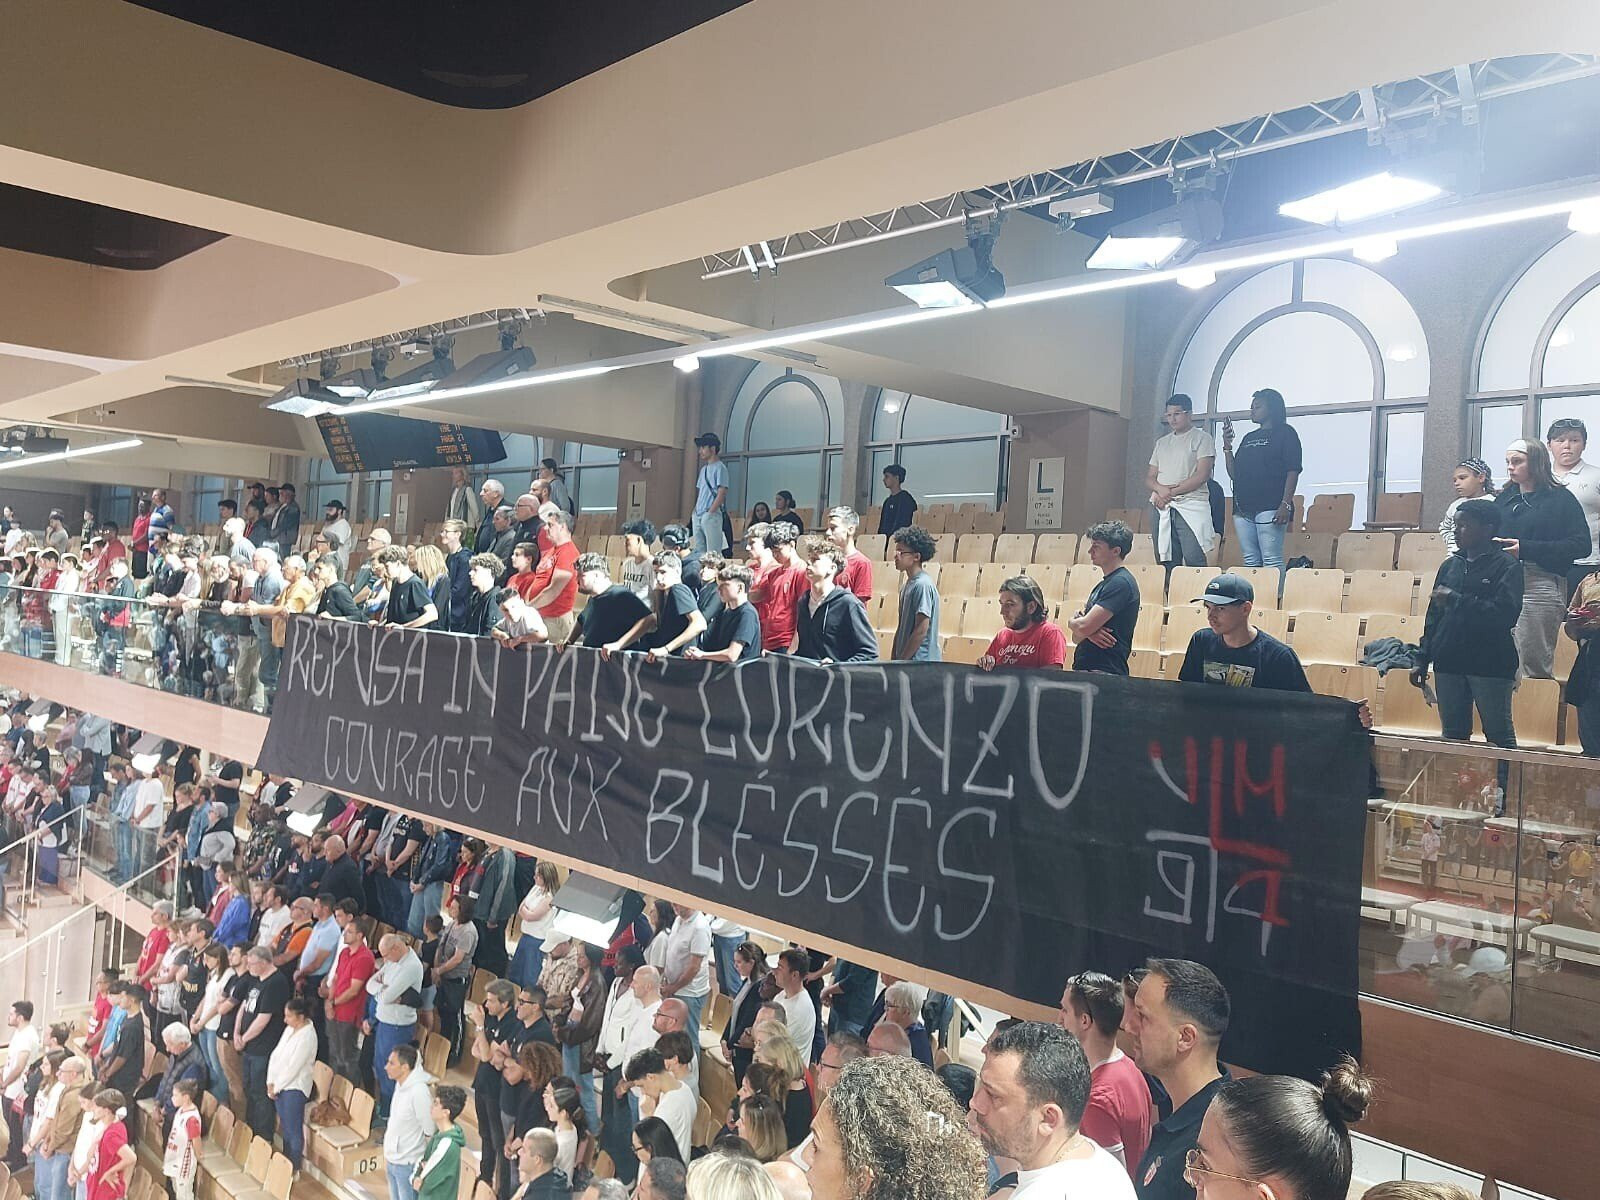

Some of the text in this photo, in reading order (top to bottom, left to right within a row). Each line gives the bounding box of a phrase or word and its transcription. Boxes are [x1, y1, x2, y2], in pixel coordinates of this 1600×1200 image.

[1037, 462, 1054, 493] L
[398, 496, 404, 514] L
[632, 484, 640, 507] L
[442, 635, 501, 719] IN
[322, 715, 998, 943] COURAGE AUX BLÉSSÉS
[359, 1156, 378, 1174] 05
